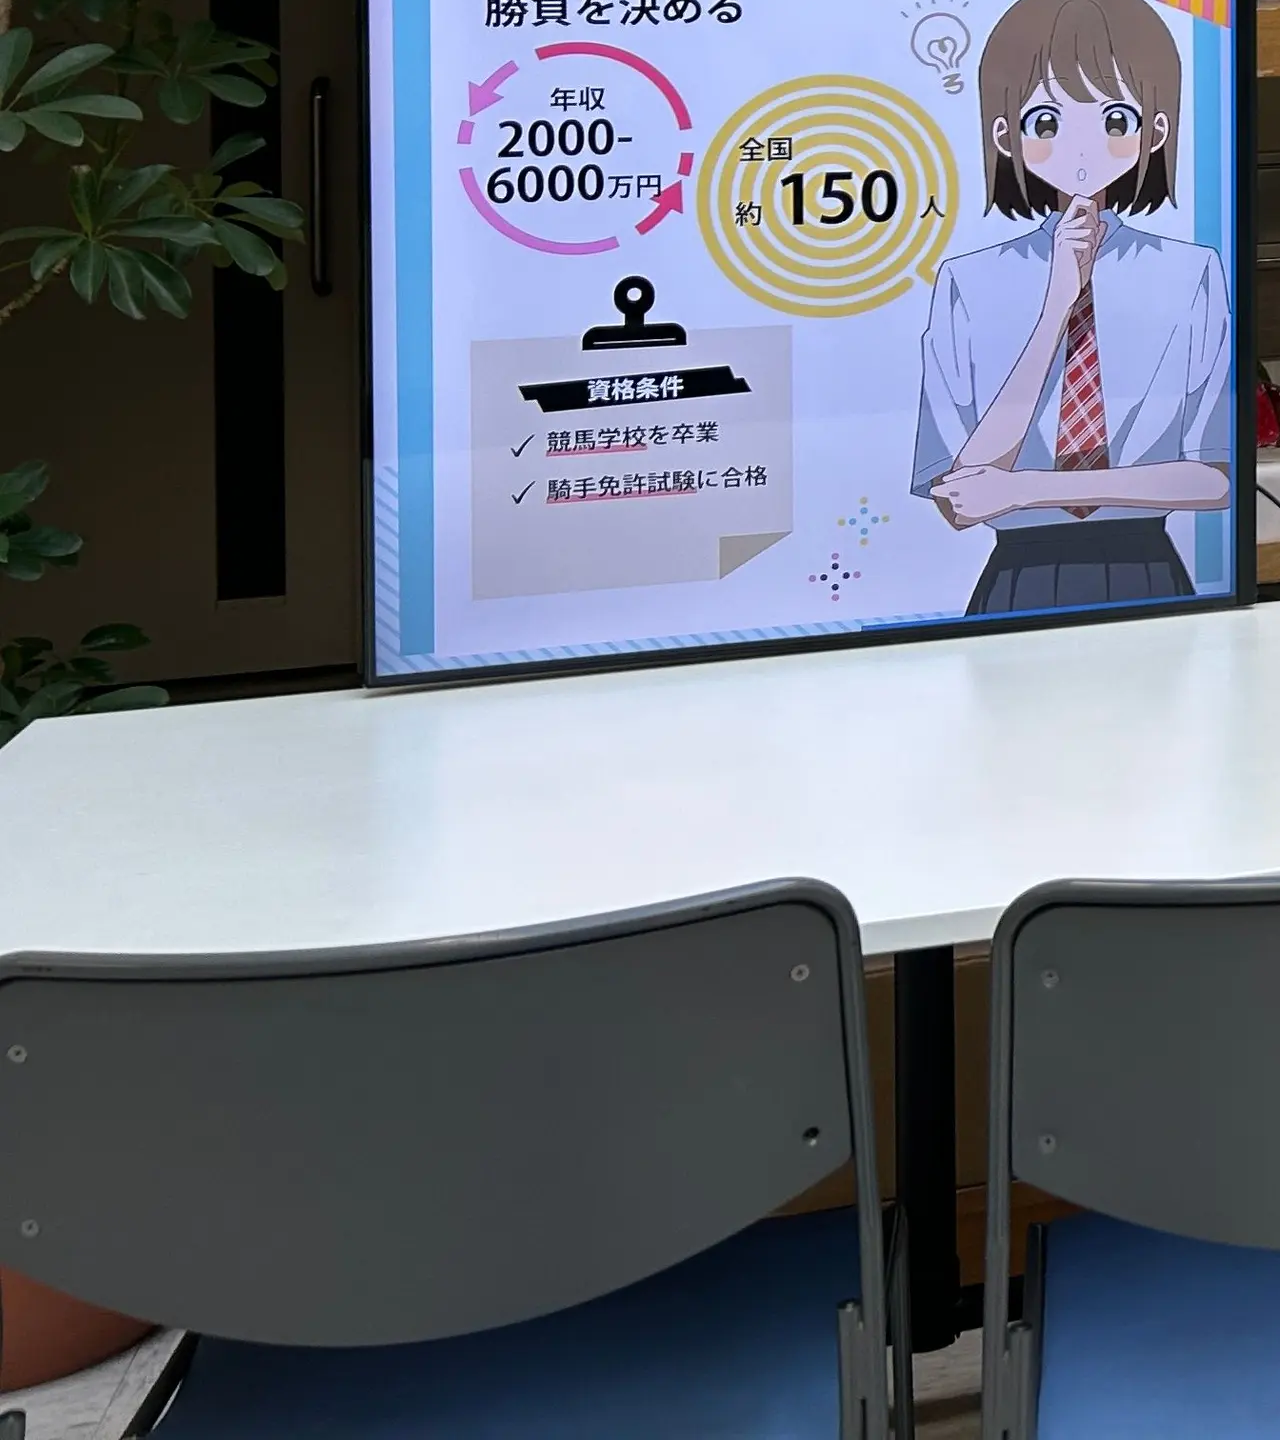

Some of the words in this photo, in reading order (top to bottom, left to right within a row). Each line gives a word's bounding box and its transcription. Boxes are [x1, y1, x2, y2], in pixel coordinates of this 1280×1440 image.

[550, 86, 606, 112] 年収
[497, 119, 634, 159] 2000-
[737, 136, 793, 162] 全国
[486, 165, 664, 206] 6000万円
[587, 375, 685, 403] 資格条件
[546, 422, 720, 454] 競馬学校を卒業
[547, 466, 769, 503] 騎手免許試験に合格
